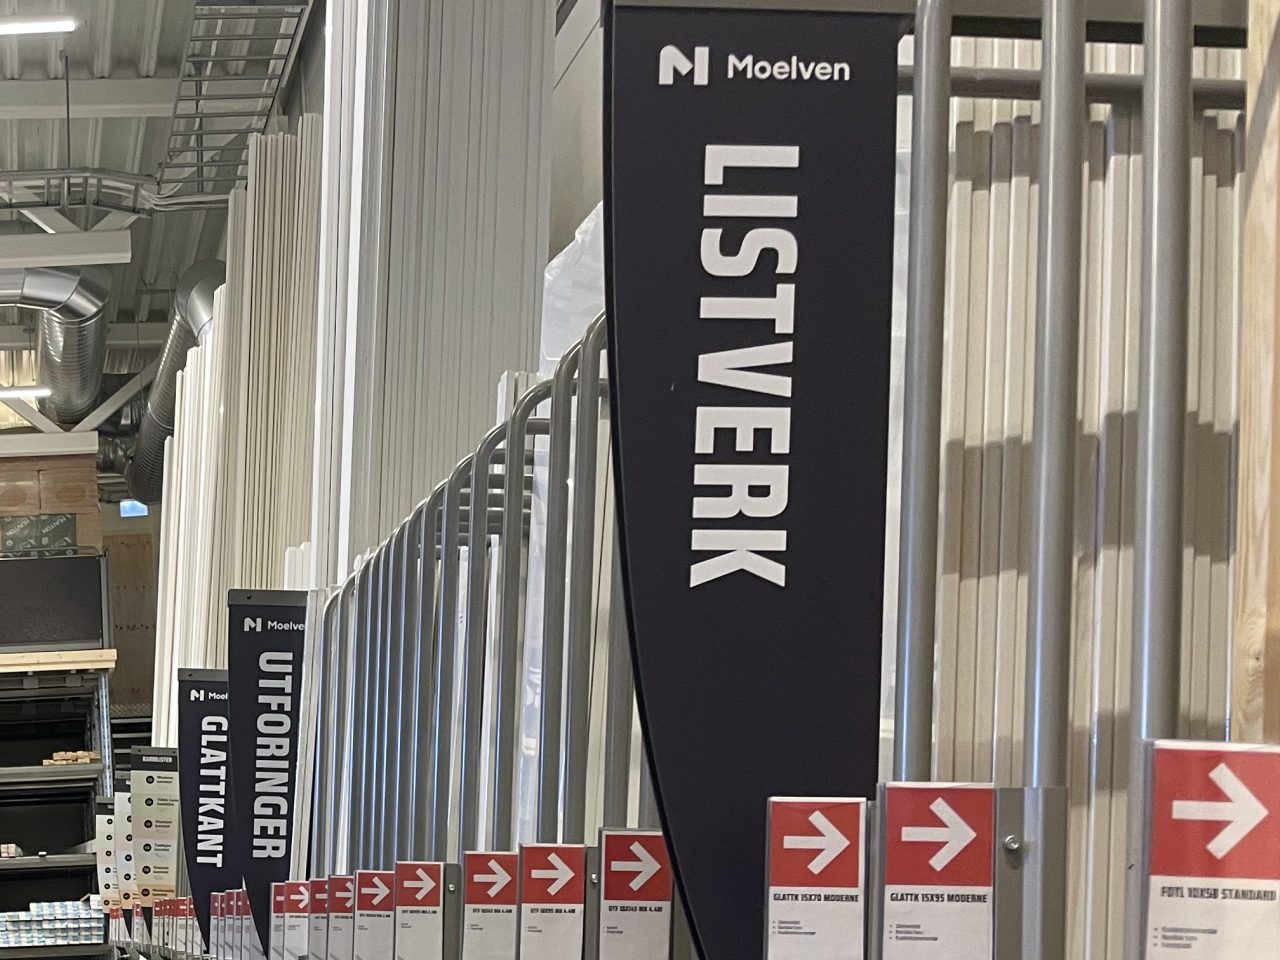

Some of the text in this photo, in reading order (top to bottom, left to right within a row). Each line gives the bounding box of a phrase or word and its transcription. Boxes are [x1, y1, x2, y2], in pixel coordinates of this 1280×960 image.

[726, 54, 851, 82] Moelven
[689, 144, 801, 588] LISTVERK
[267, 620, 305, 632] Moelve
[208, 692, 228, 701] Moel
[252, 651, 293, 859] UTFORINGER
[196, 715, 229, 868] GLATTKANT
[773, 893, 800, 901] GLATTK
[823, 894, 860, 903] MODERNE
[890, 892, 988, 903] GLATTK 15X95 MODERNE
[1220, 888, 1278, 901] STANDARD
